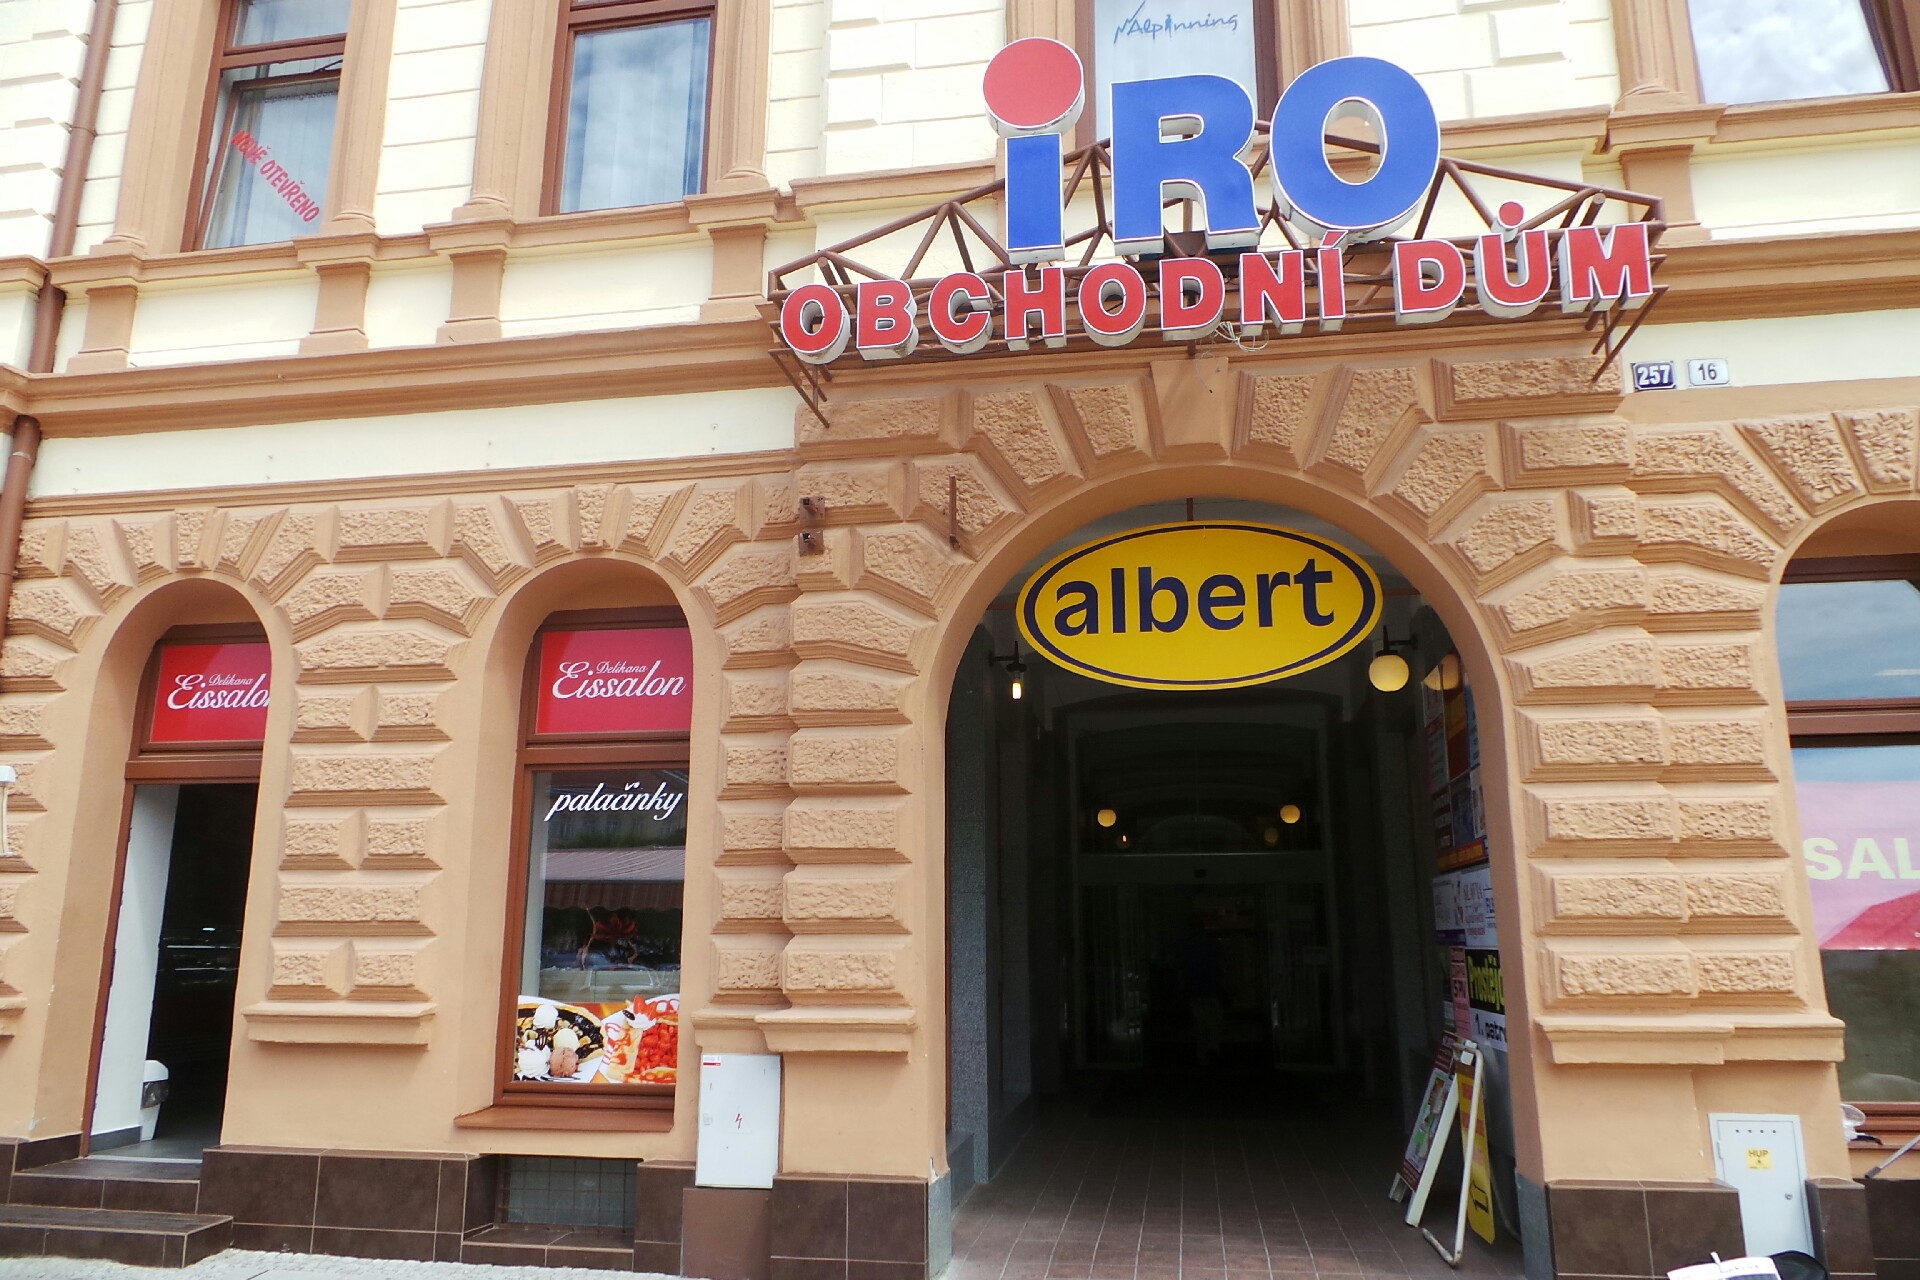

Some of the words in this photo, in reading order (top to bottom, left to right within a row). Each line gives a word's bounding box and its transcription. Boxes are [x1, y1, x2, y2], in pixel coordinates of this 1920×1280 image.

[983, 37, 1441, 259] iRO
[231, 130, 271, 165] NOVĚ
[260, 159, 320, 222] OTEVŘENO
[780, 231, 1347, 358] OBCHODNÍ
[1394, 201, 1653, 320] DŮM
[1637, 364, 1670, 386] 257
[1698, 362, 1718, 381] 16
[1054, 558, 1335, 637] albert
[208, 674, 253, 686] Delikana
[552, 660, 687, 698] Eissalon
[596, 661, 648, 674] Delikana
[167, 673, 270, 710] Eissalo
[544, 781, 683, 822] palačinky
[1802, 837, 1920, 880] SAL
[1748, 1149, 1769, 1158] HUP
